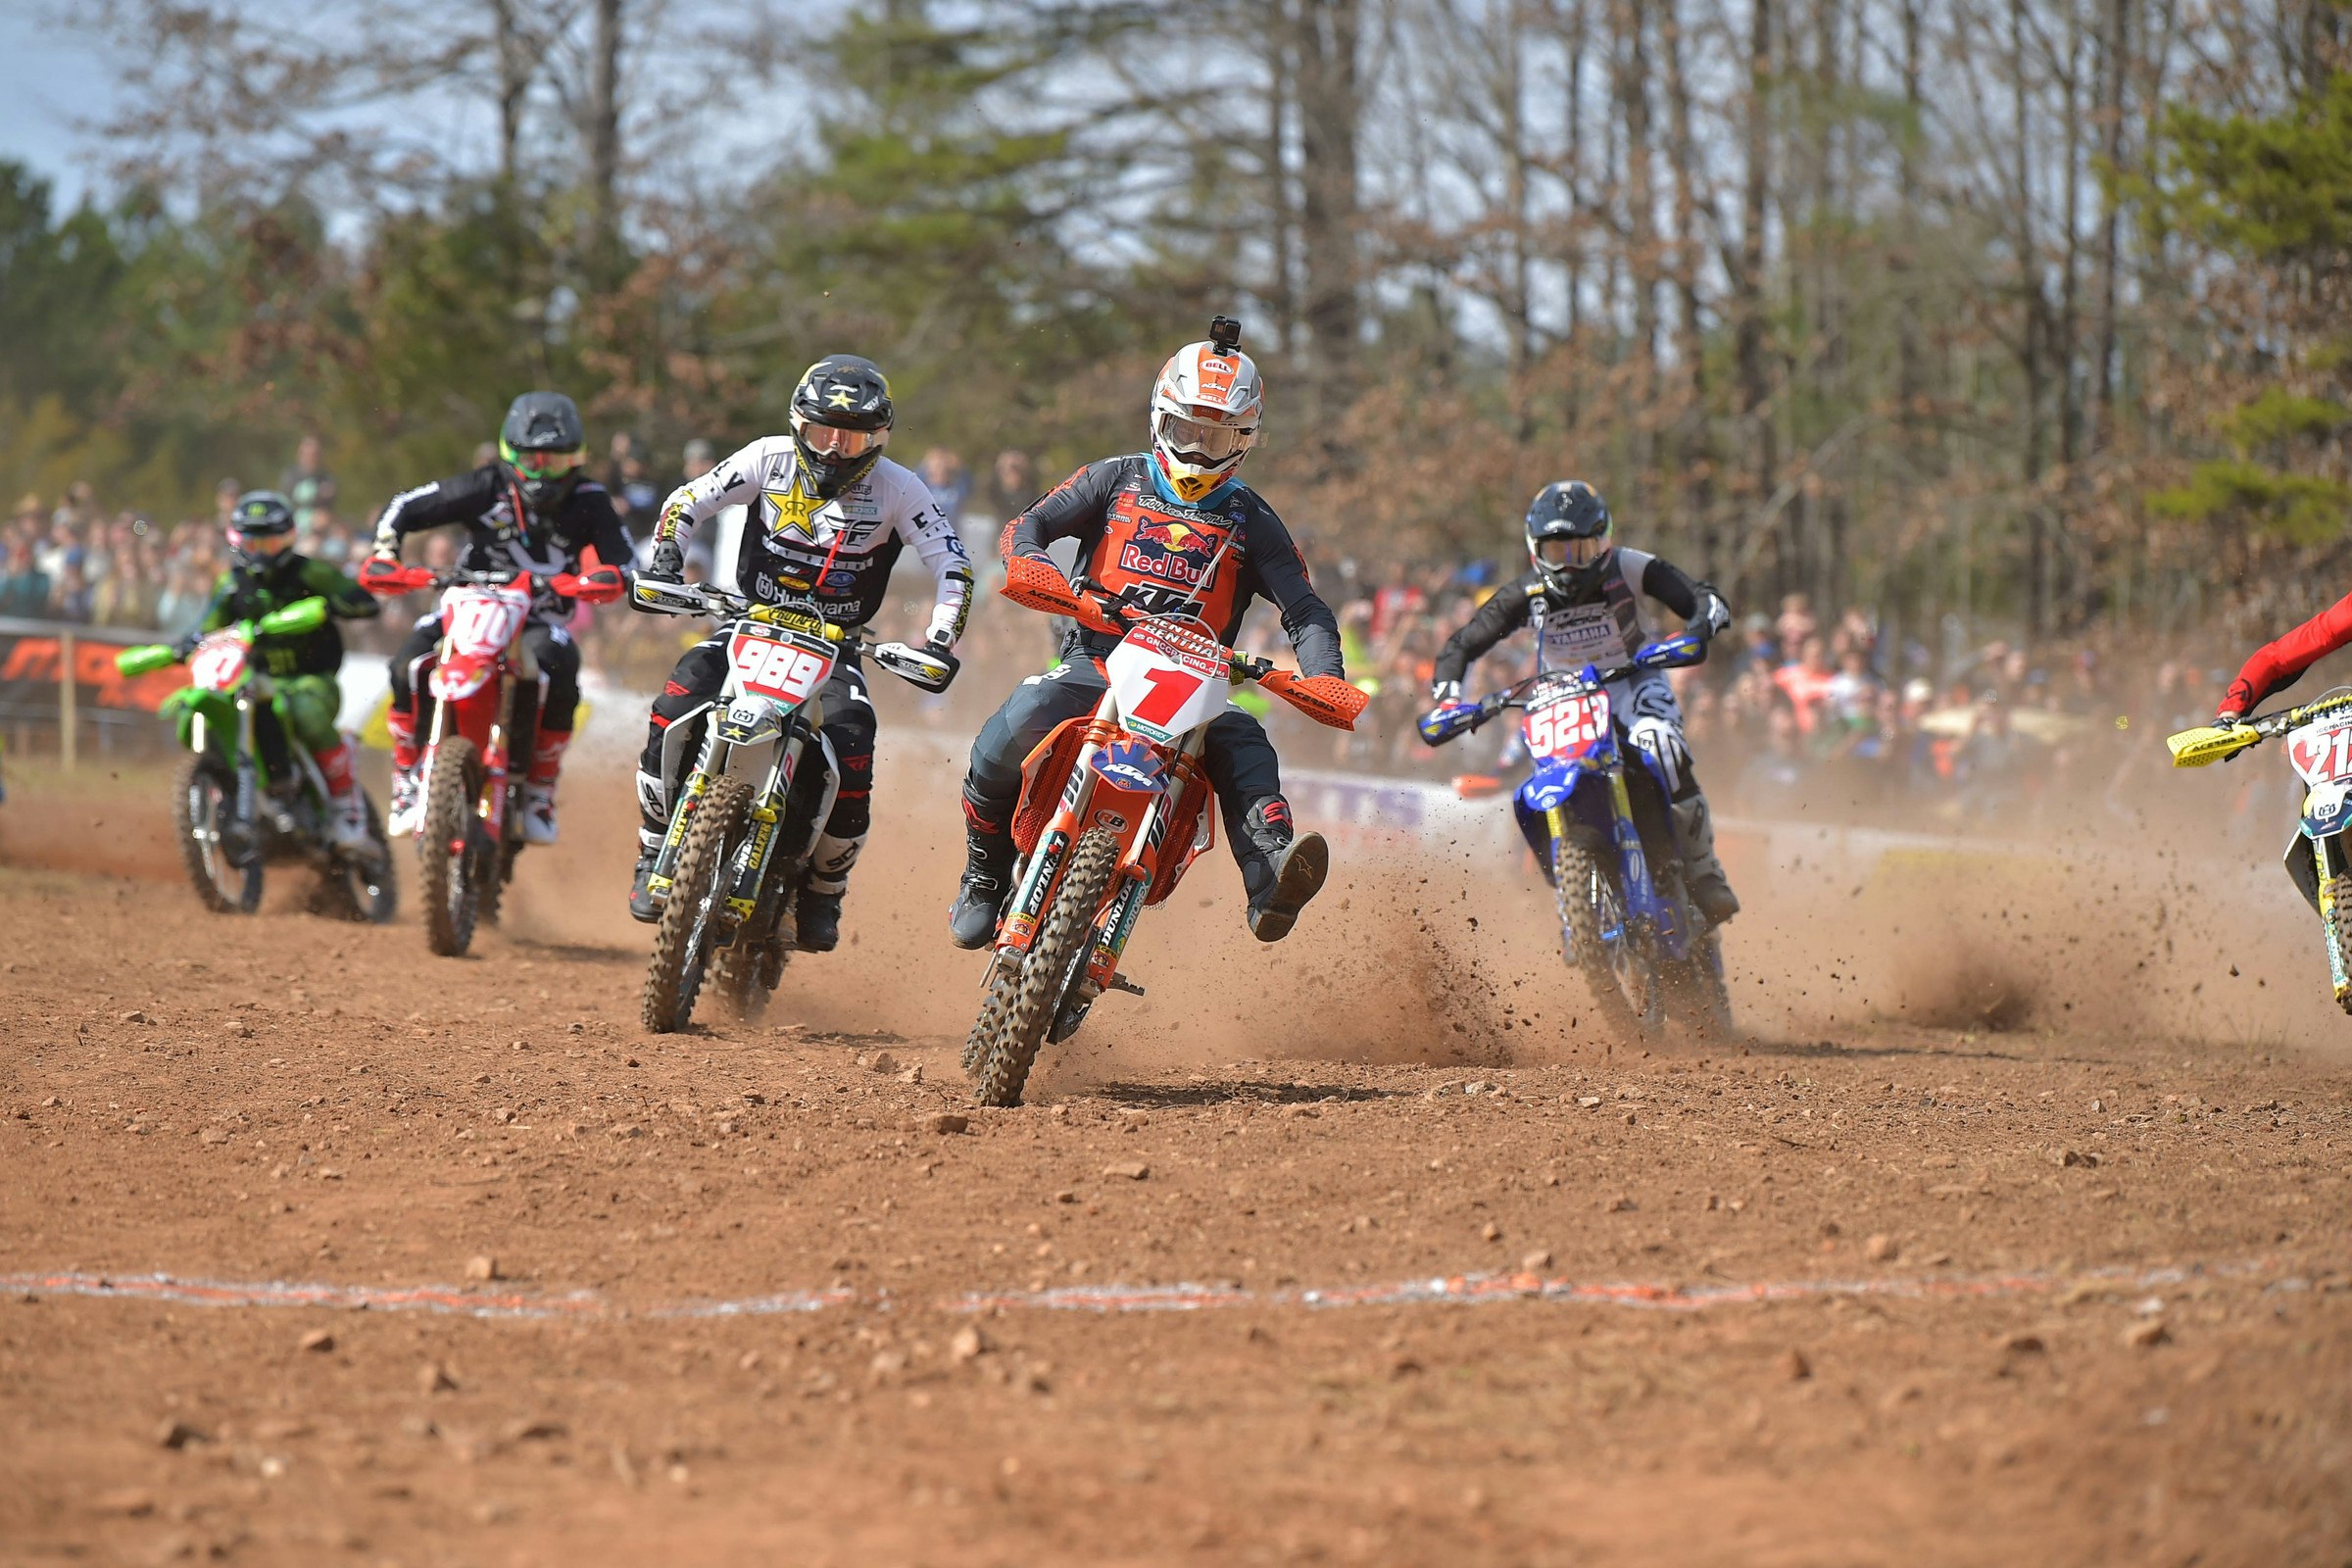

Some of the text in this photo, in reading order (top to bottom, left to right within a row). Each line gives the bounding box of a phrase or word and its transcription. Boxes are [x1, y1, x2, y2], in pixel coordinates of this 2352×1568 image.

[1205, 362, 1229, 372] BELL
[1200, 395, 1223, 404] BELL
[1121, 544, 1171, 577] Red
[1026, 589, 1079, 612] ACERBIS
[737, 639, 823, 700] 989
[1131, 667, 1203, 727] 1
[1284, 687, 1336, 712] ACERBIS
[1136, 722, 1166, 740] MOTOREX
[1529, 694, 1609, 760] 523
[2191, 737, 2237, 752] ACERBIS
[2306, 728, 2352, 786] 21
[1102, 762, 1153, 787] KTM
[1123, 881, 1151, 937] MOTOREX
